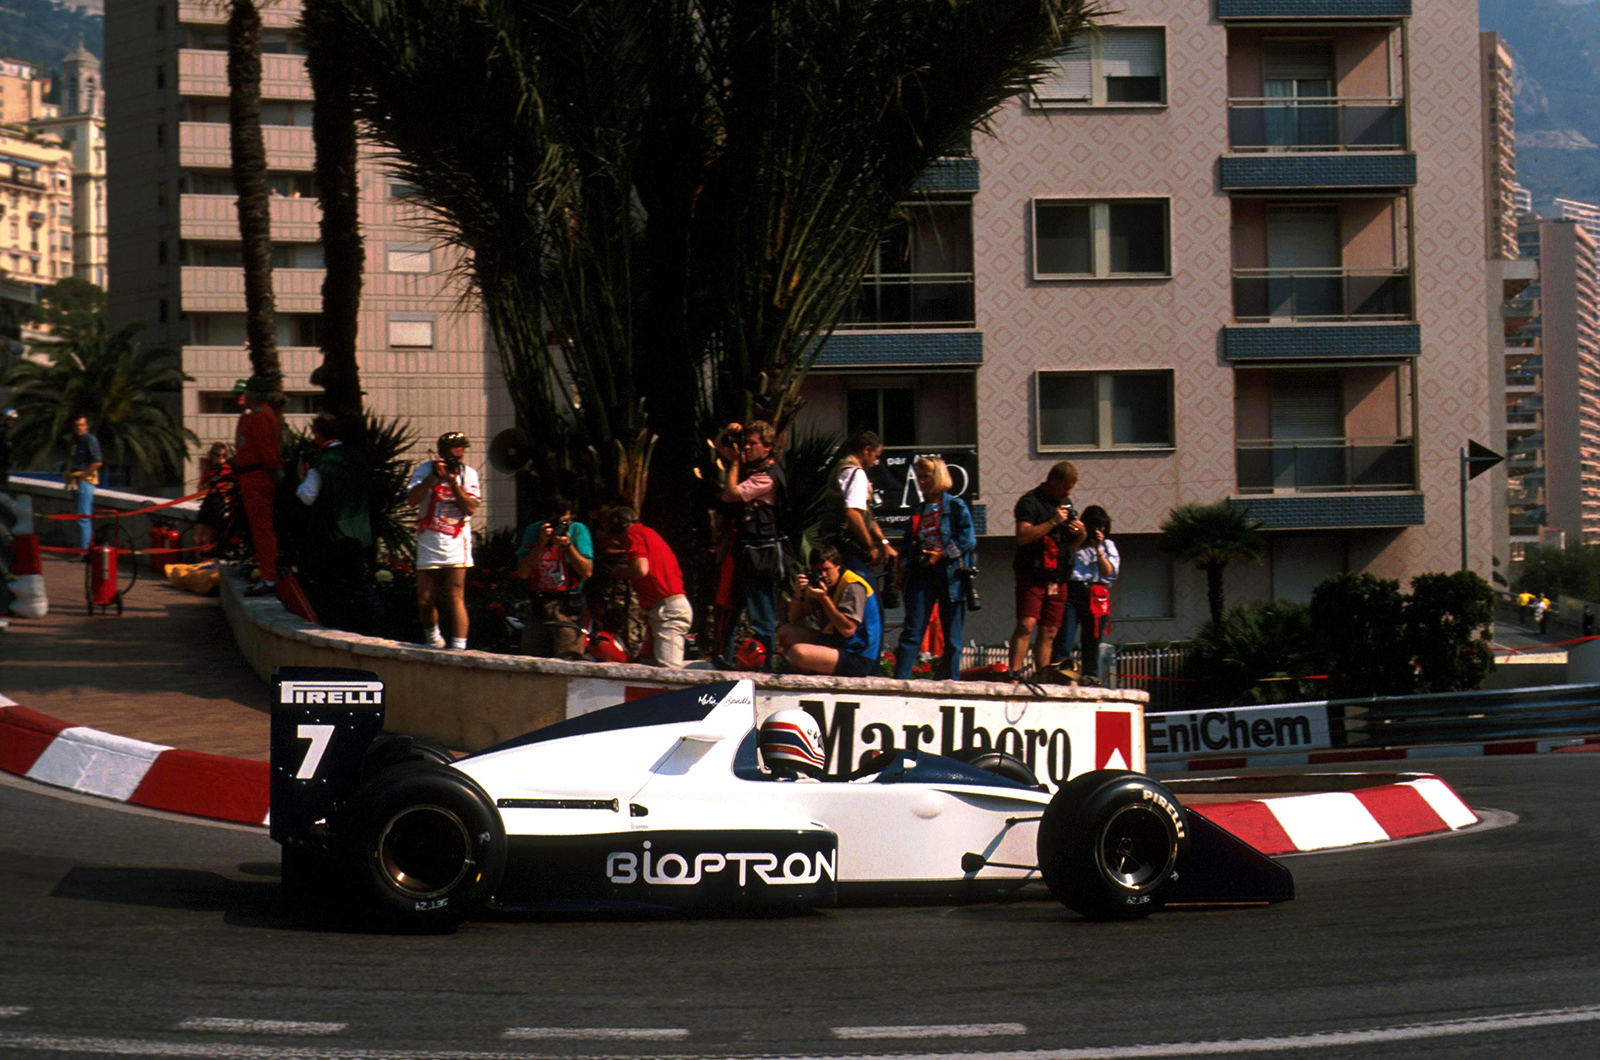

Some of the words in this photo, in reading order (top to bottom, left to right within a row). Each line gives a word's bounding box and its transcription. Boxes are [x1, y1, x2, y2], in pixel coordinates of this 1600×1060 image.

[280, 680, 384, 704] PIRELLI
[295, 724, 336, 780] 7
[1145, 711, 1311, 753] EniChem
[1142, 789, 1185, 838] PIRELLI
